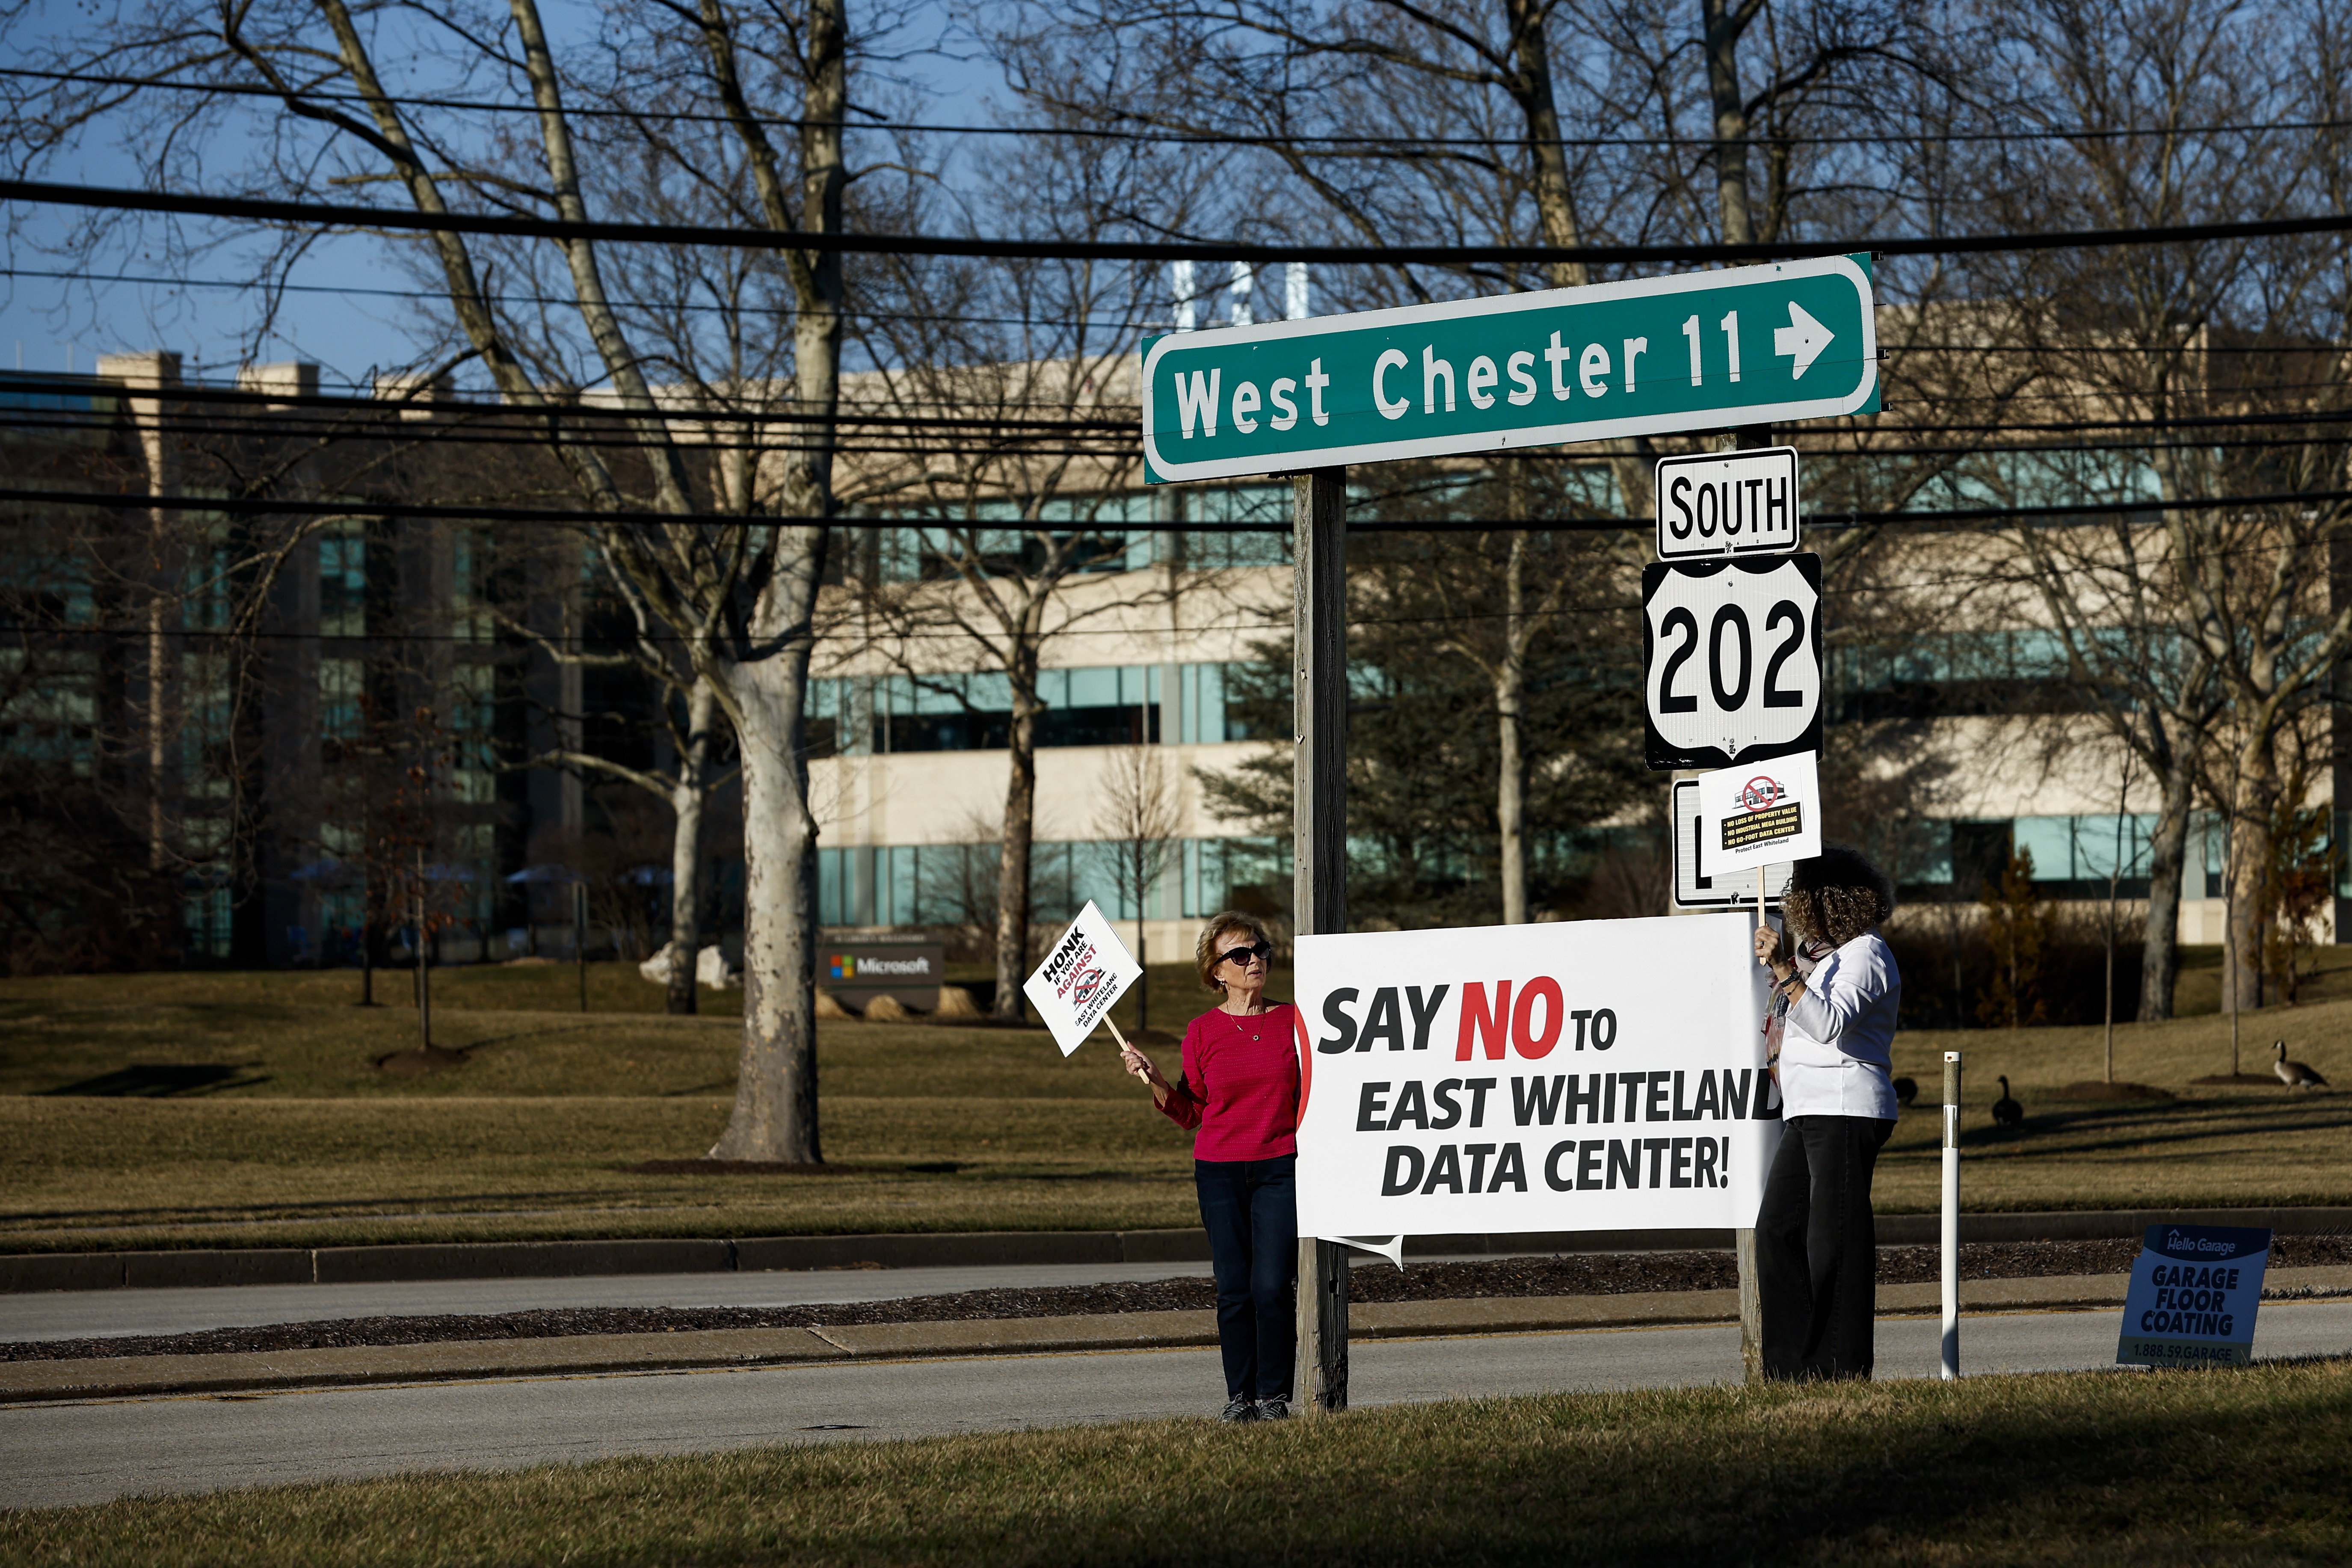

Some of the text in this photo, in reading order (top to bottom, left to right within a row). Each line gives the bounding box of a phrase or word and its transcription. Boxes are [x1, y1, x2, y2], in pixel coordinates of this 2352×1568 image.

[1174, 310, 1741, 439] West Chester 11
[1669, 476, 1787, 540] SOUTH
[1660, 599, 1805, 714] 202
[1735, 817, 1747, 826] LOSS
[1755, 810, 1781, 821] PROPERTY
[1781, 806, 1797, 815] VALUE
[1736, 824, 1761, 835] INDUSTRIAL
[1761, 820, 1775, 828] MEGA
[1776, 816, 1798, 826] BUILDING
[1736, 833, 1758, 844] 60-FOOT
[1759, 830, 1773, 838] DATA
[1774, 825, 1795, 835] CENTER
[1735, 845, 1752, 854] Protect
[1764, 837, 1789, 847] Whiteland
[857, 956, 930, 975] Microsoft
[1042, 925, 1085, 983] HONK
[1054, 940, 1088, 986] IF YOU ARE
[1057, 943, 1097, 1000] AGAINST
[1075, 972, 1117, 1027] EAST WHITELAND
[1083, 984, 1118, 1028] DATA CENTER
[1317, 976, 1617, 1061] SAY NO TO
[1356, 1068, 1783, 1132] EAST WHITELAND
[1381, 1136, 1730, 1196] DATA CENTER!
[2167, 1236, 2236, 1256] Hello Garage
[2151, 1265, 2239, 1290] GARAGE
[2155, 1288, 2225, 1312] FLOOR
[2140, 1310, 2234, 1336] COATING
